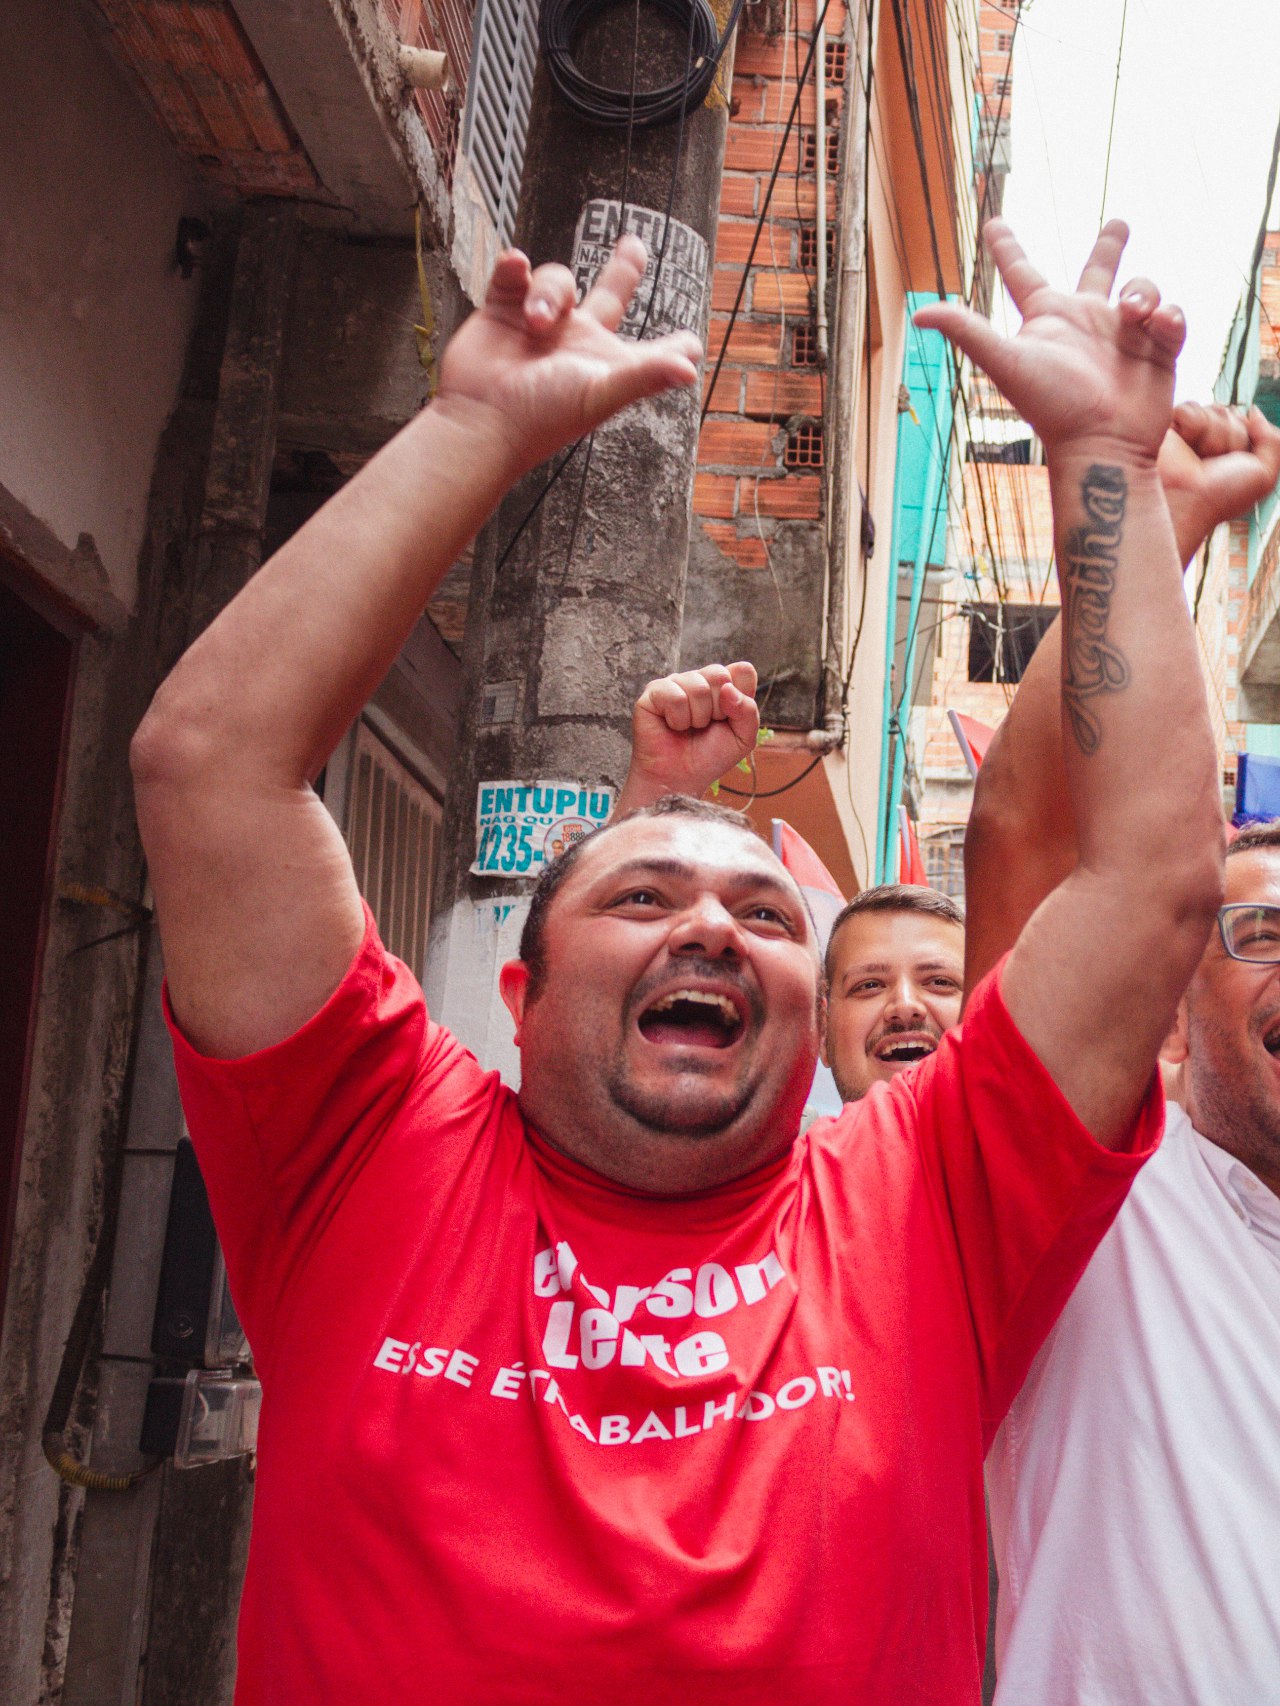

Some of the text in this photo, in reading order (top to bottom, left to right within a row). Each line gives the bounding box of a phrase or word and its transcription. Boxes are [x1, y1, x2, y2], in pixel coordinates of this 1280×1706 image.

[480, 787, 609, 819] ENTUPIU
[373, 1337, 480, 1389] ESSE
[490, 1361, 526, 1401] É
